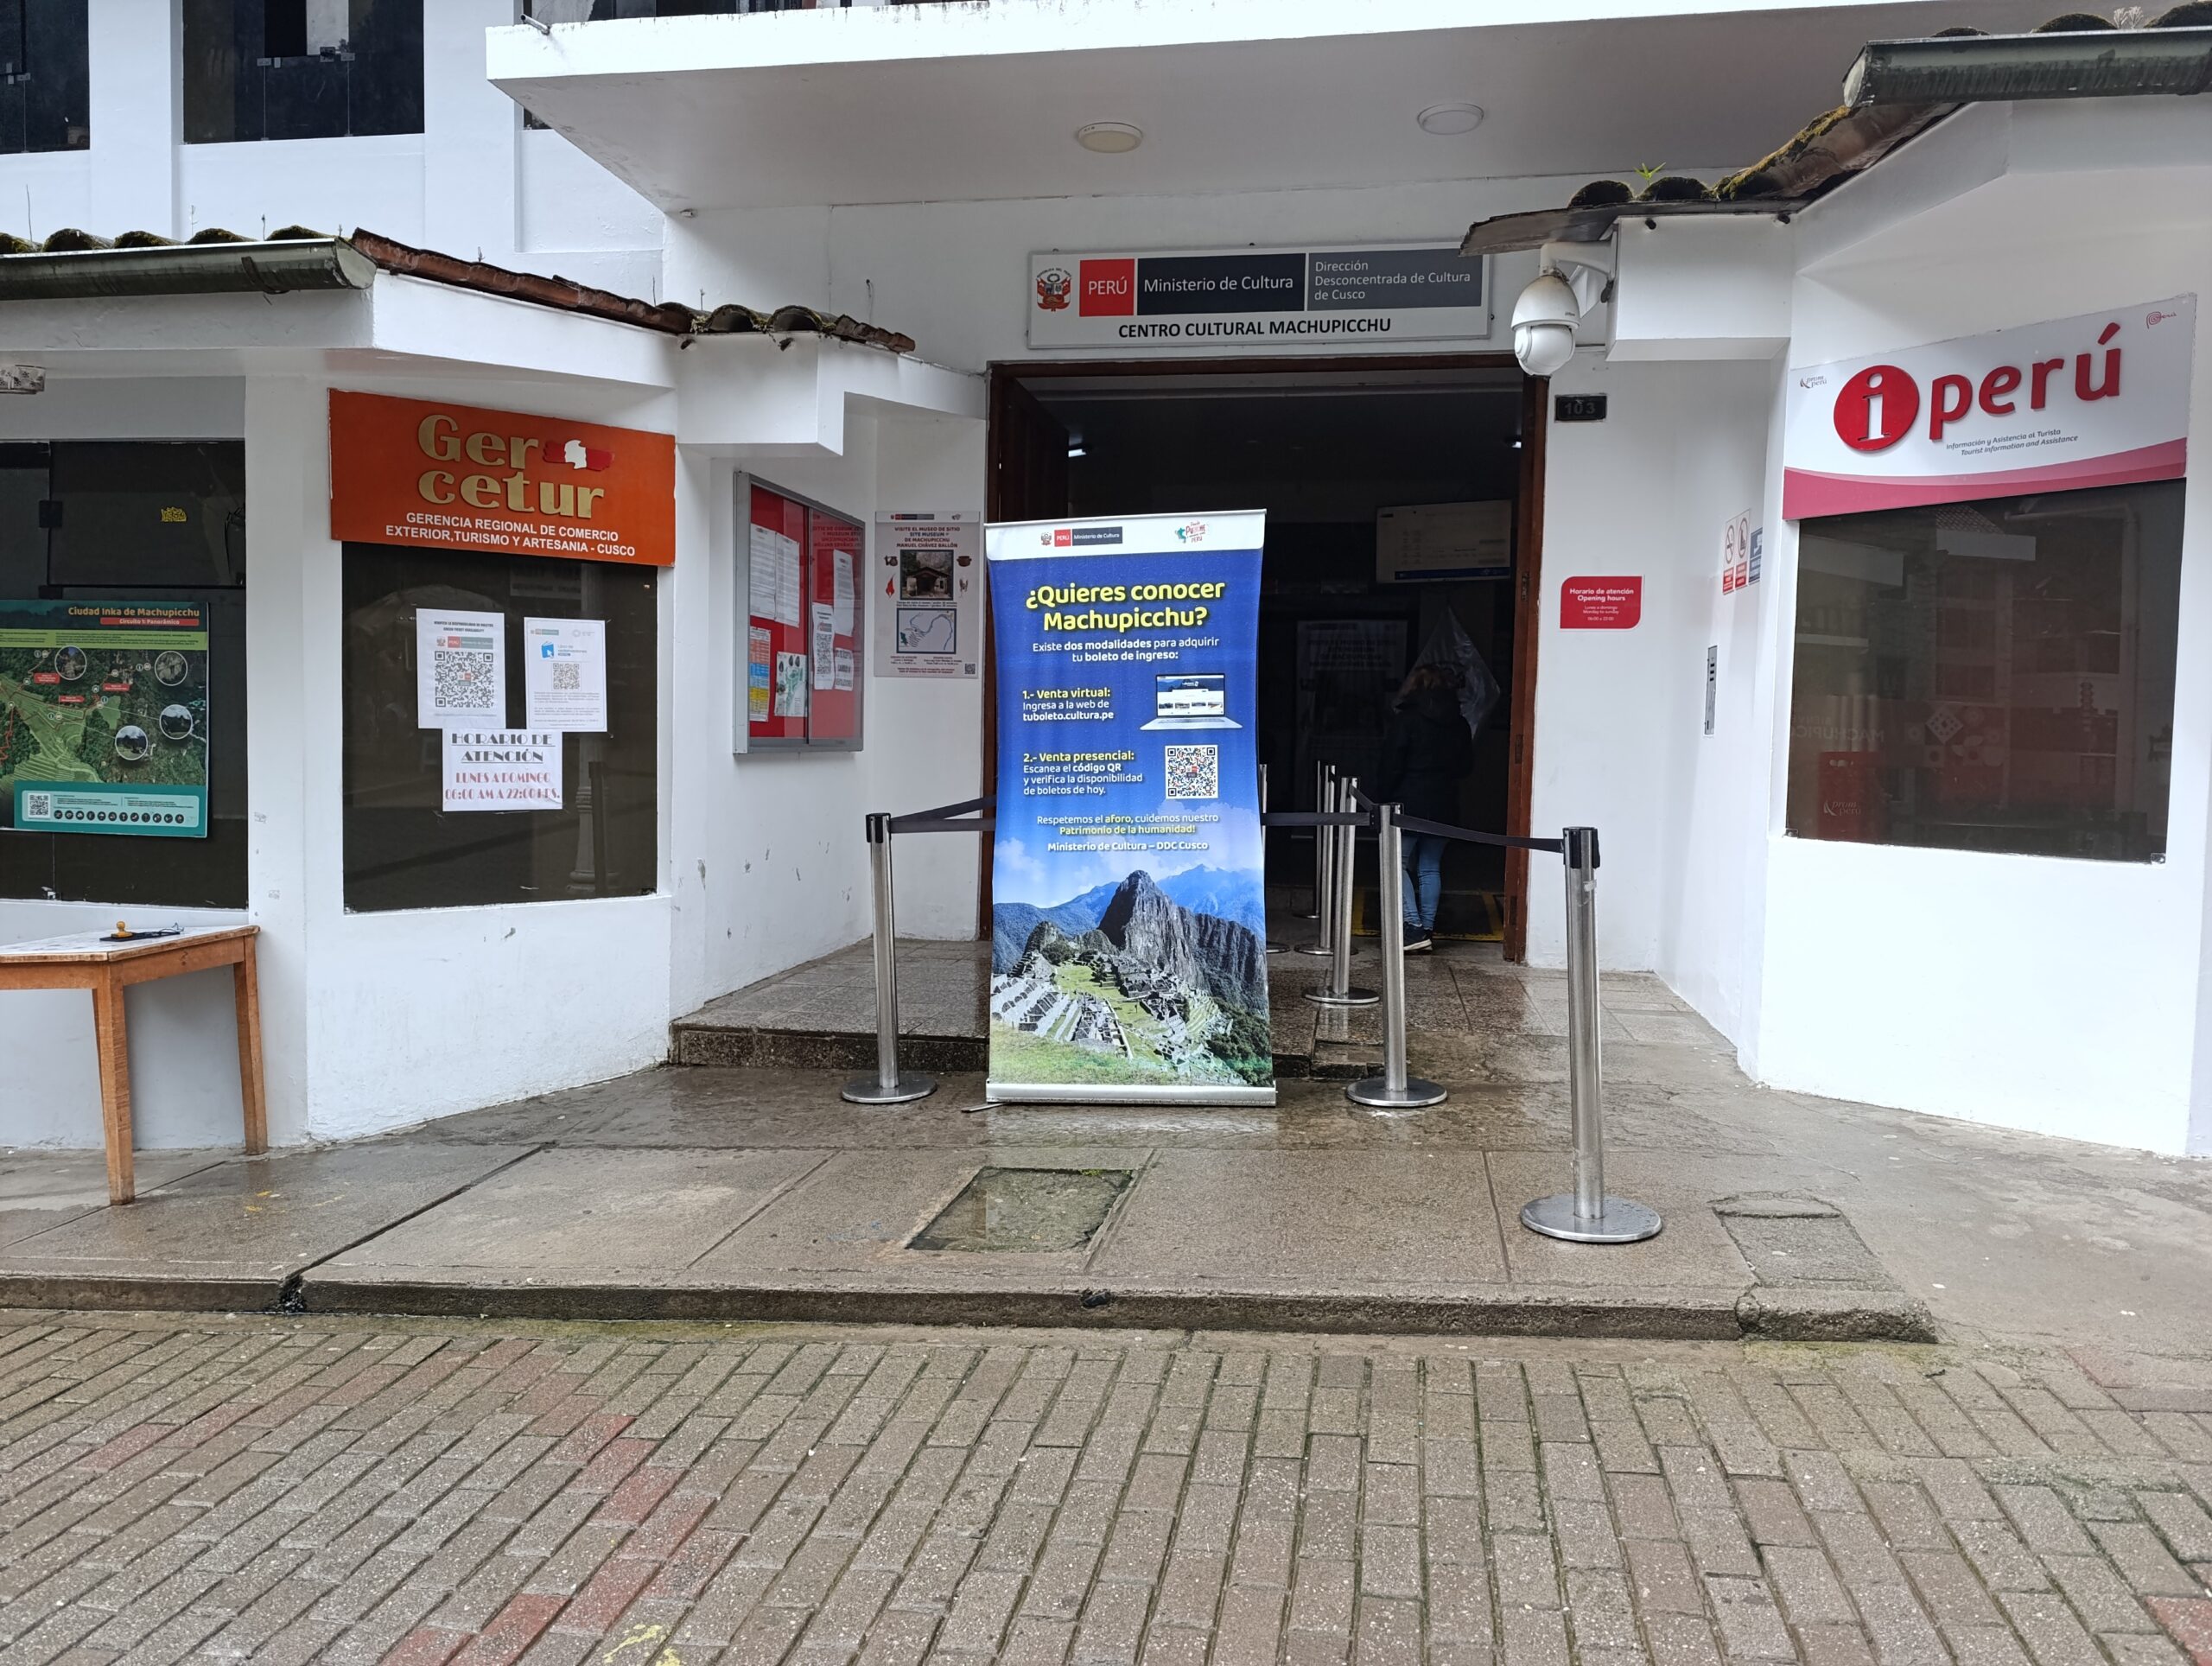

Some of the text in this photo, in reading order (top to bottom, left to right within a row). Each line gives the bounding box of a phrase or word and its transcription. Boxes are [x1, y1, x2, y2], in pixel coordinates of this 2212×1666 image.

[1315, 259, 1369, 272] Dirección
[1088, 275, 1128, 296] PERÚ
[1144, 276, 1294, 294] Ministerio de Cultura
[1315, 272, 1471, 286] Desconcentrada de Cultura
[1314, 289, 1365, 300] de Cusco
[1118, 317, 1391, 339] CENTRO CULTURAL MACHUPICCHU
[1929, 322, 2121, 443] perú
[418, 414, 538, 469] Ger
[1947, 439, 1985, 449] Información
[1993, 434, 2026, 443] Asistencia
[1985, 443, 2024, 453] Information
[2041, 436, 2078, 445] Assistance
[418, 470, 604, 518] cetur
[406, 512, 619, 541] GERENCIA REGIONAL DE COMERCIO
[512, 536, 520, 546] Y
[523, 537, 588, 552] ARTESANIA
[597, 543, 635, 556] CUSCO
[1026, 582, 1225, 608] ¿Quieres conocer
[68, 607, 99, 615] Ciudad
[137, 607, 200, 618] Machupicchu
[1044, 606, 1207, 633] Machupicchu?
[1033, 637, 1219, 652] Existe dos modalidades para adquirir
[1072, 651, 1179, 663] tu boleto de ingreso:
[1022, 688, 1110, 699] 1.- Venta virtual:
[1023, 702, 1056, 712] Ingresa
[1098, 699, 1109, 708] de
[1023, 711, 1114, 722] tuboleto.cultura.pe
[452, 734, 552, 745] HORARIO DE
[461, 749, 543, 761] ATENCIÓN
[1023, 750, 1135, 762] 2.- Venta presencial:
[1073, 762, 1105, 773] código
[1108, 763, 1122, 773] QR
[1031, 775, 1065, 784] verifica
[1077, 773, 1143, 784] disponibilidad
[1037, 785, 1071, 794] boletos
[1087, 785, 1106, 796] hoy.
[1037, 816, 1093, 825] Respetemos
[1105, 814, 1134, 823] aforo,
[1135, 814, 1179, 823] cuidemos
[1182, 813, 1218, 822] nuestro
[1059, 824, 1196, 835] Patrimonio de la humanidad!
[1047, 842, 1096, 851] Ministerio
[1112, 842, 1147, 850] Cultura
